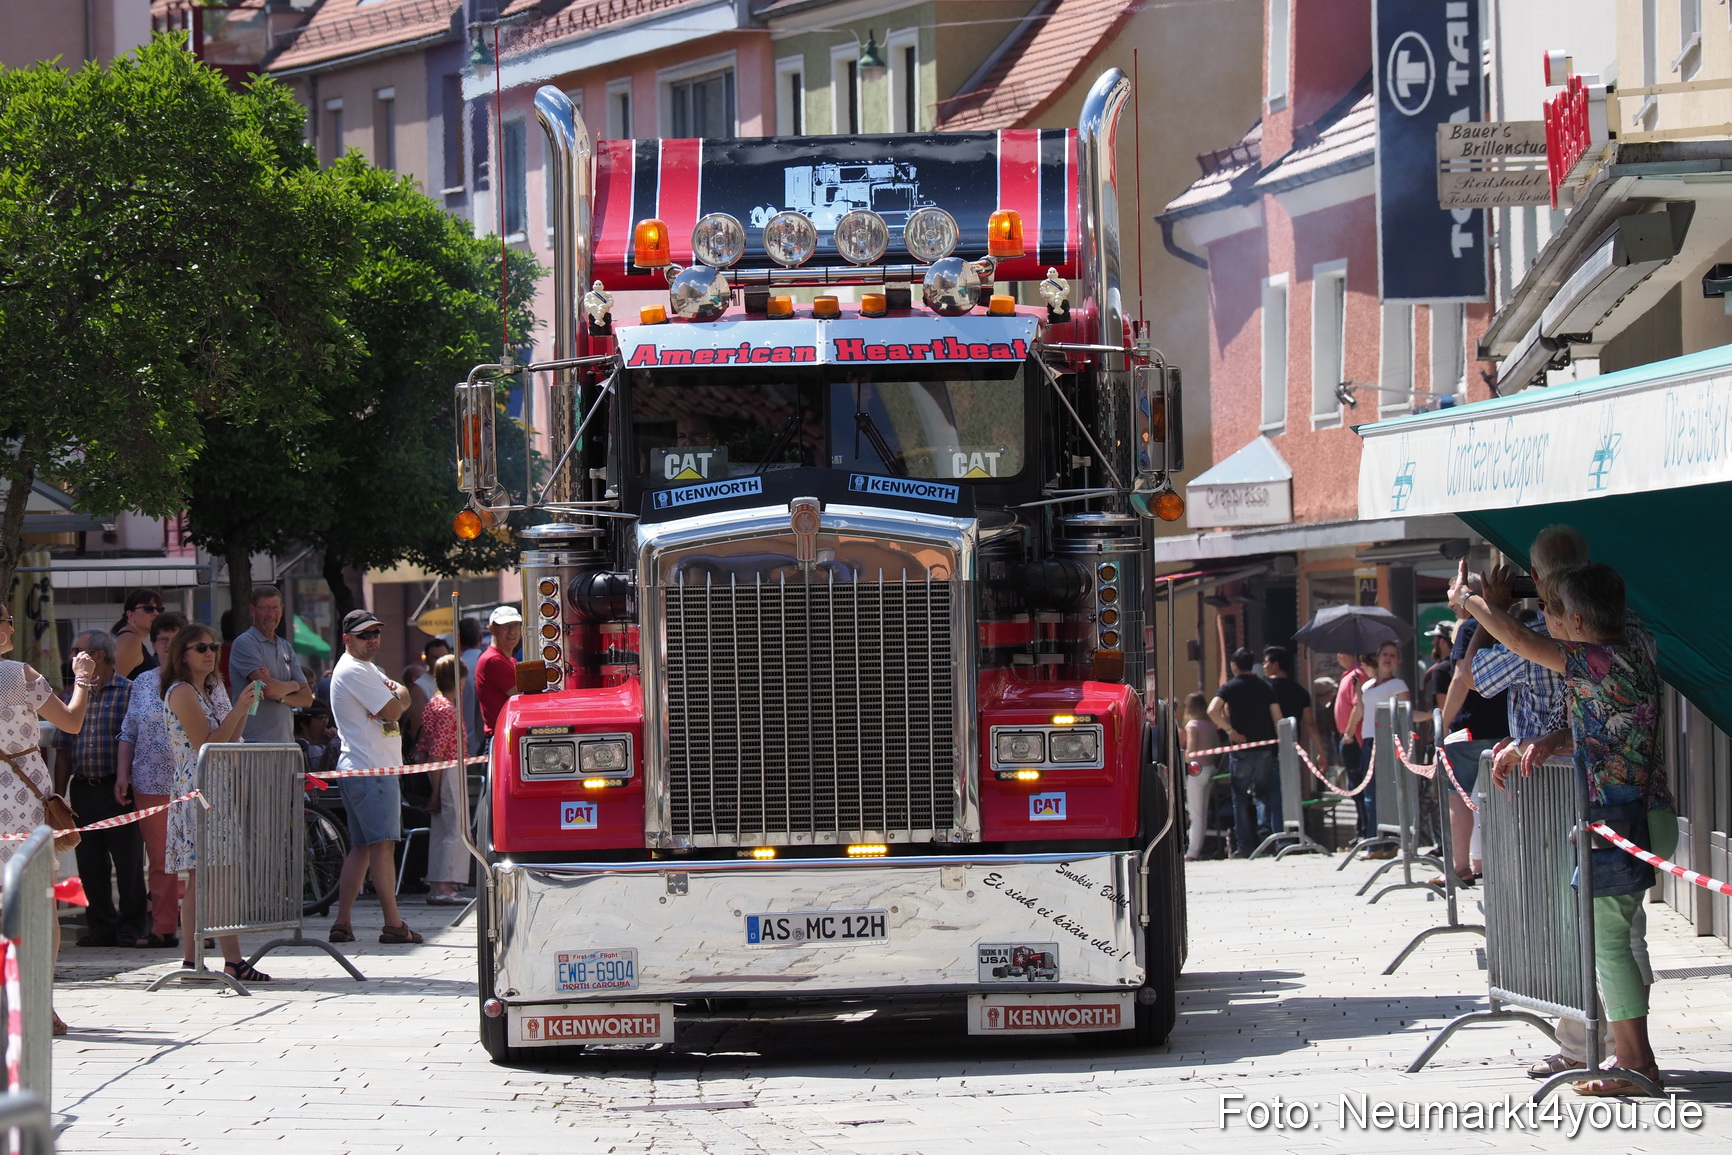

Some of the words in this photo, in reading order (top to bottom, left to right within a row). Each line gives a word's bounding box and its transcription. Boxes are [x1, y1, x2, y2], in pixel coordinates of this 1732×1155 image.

[1449, 123, 1511, 140] Bauer's
[1492, 191, 1511, 203] der
[627, 341, 817, 368] American
[833, 335, 1028, 363] Heartbeat
[664, 452, 713, 480] CAT
[952, 451, 1001, 479] CAT
[675, 479, 760, 503] KENWORTH
[870, 478, 956, 501] KENWORTH
[564, 808, 593, 824] CAT
[1033, 797, 1062, 814] CAT
[1055, 862, 1100, 890] Smokin'
[1100, 885, 1131, 909] Bullet
[983, 872, 1005, 890] Ei
[1005, 887, 1039, 909] sink
[1037, 906, 1054, 918] ei
[1052, 914, 1089, 940] kään
[761, 918, 791, 941] AS
[806, 917, 836, 939] MC
[841, 915, 886, 938] 12H
[599, 952, 619, 960] Flight
[980, 956, 1008, 964] USA
[558, 960, 634, 984] EWB-6904
[562, 982, 590, 990] NORTH
[592, 980, 631, 989] CAROLINA
[548, 1017, 657, 1037] KENWORTH
[1008, 1008, 1117, 1026] KENWORTH
